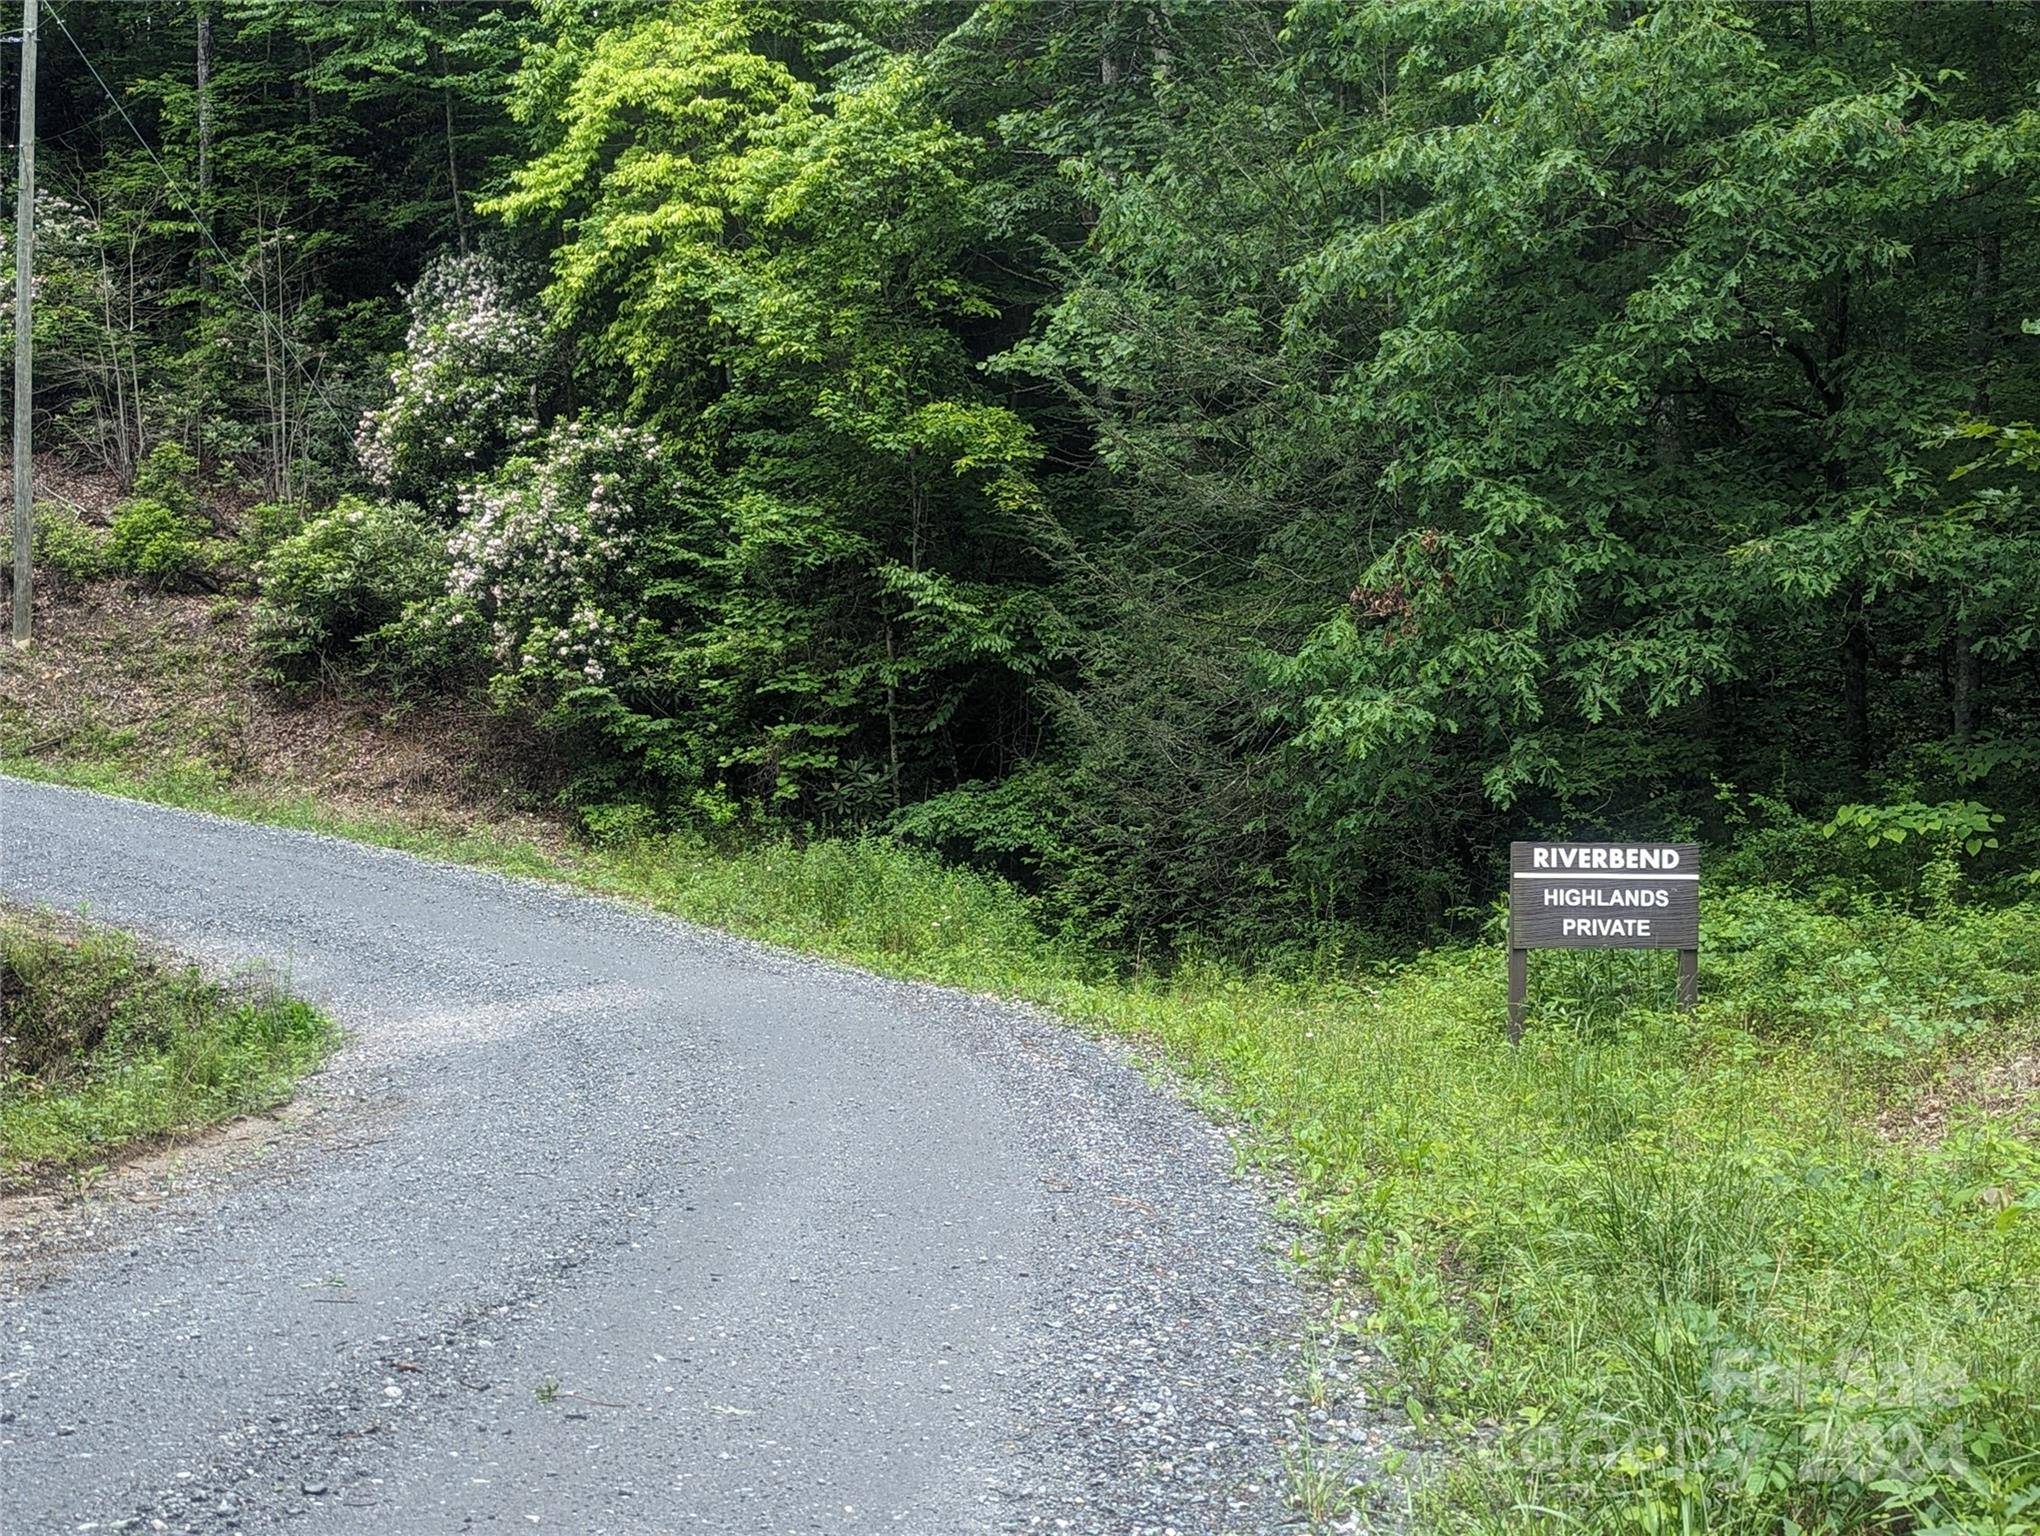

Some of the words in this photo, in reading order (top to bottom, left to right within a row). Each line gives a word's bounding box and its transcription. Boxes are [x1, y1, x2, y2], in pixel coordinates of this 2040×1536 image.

[1533, 847, 1680, 870] RIVERBEND
[1544, 888, 1669, 907] HIGHLANDS
[1562, 918, 1651, 936] PRIVATE
